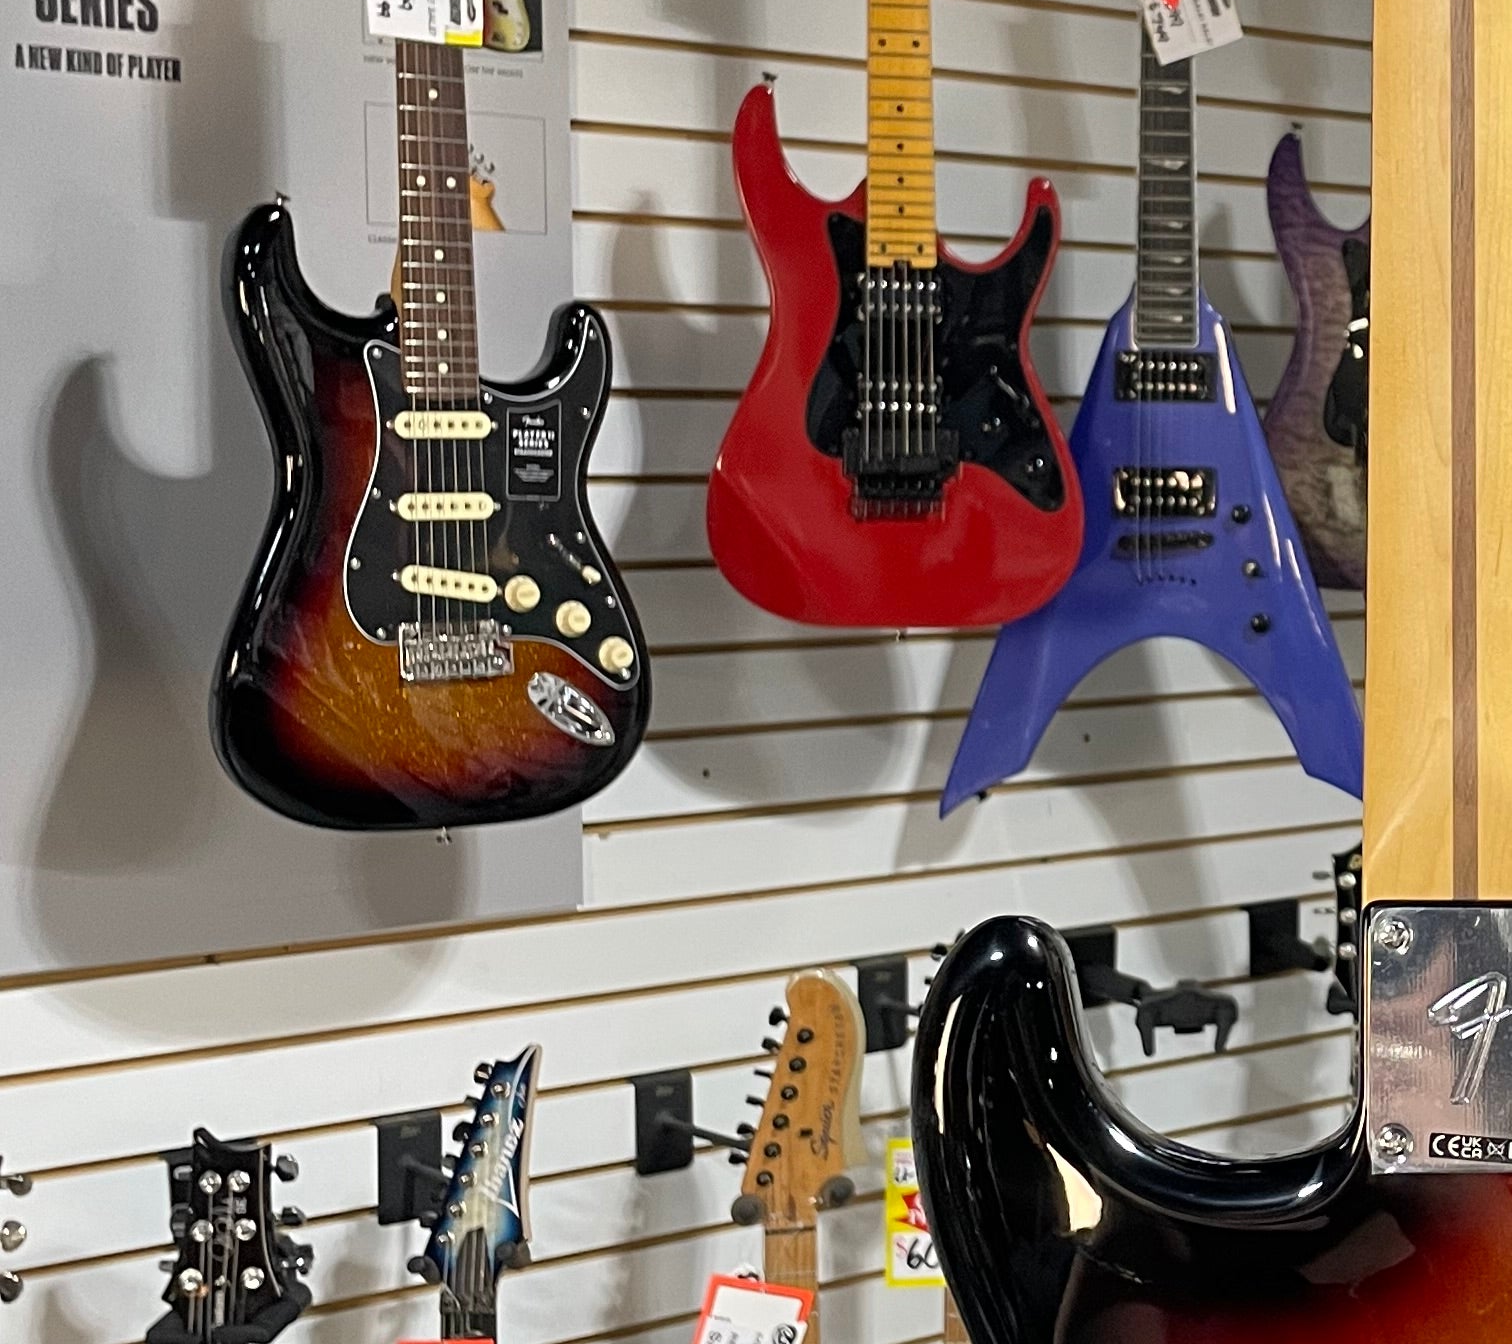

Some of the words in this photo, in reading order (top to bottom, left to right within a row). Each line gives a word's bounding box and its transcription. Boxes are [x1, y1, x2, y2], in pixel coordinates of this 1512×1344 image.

[15, 43, 25, 69] A
[28, 45, 62, 72] NEW
[66, 49, 103, 76] KIND
[106, 53, 124, 78] OF
[127, 56, 182, 83] PLAYER
[1461, 1137, 1481, 1148] UK
